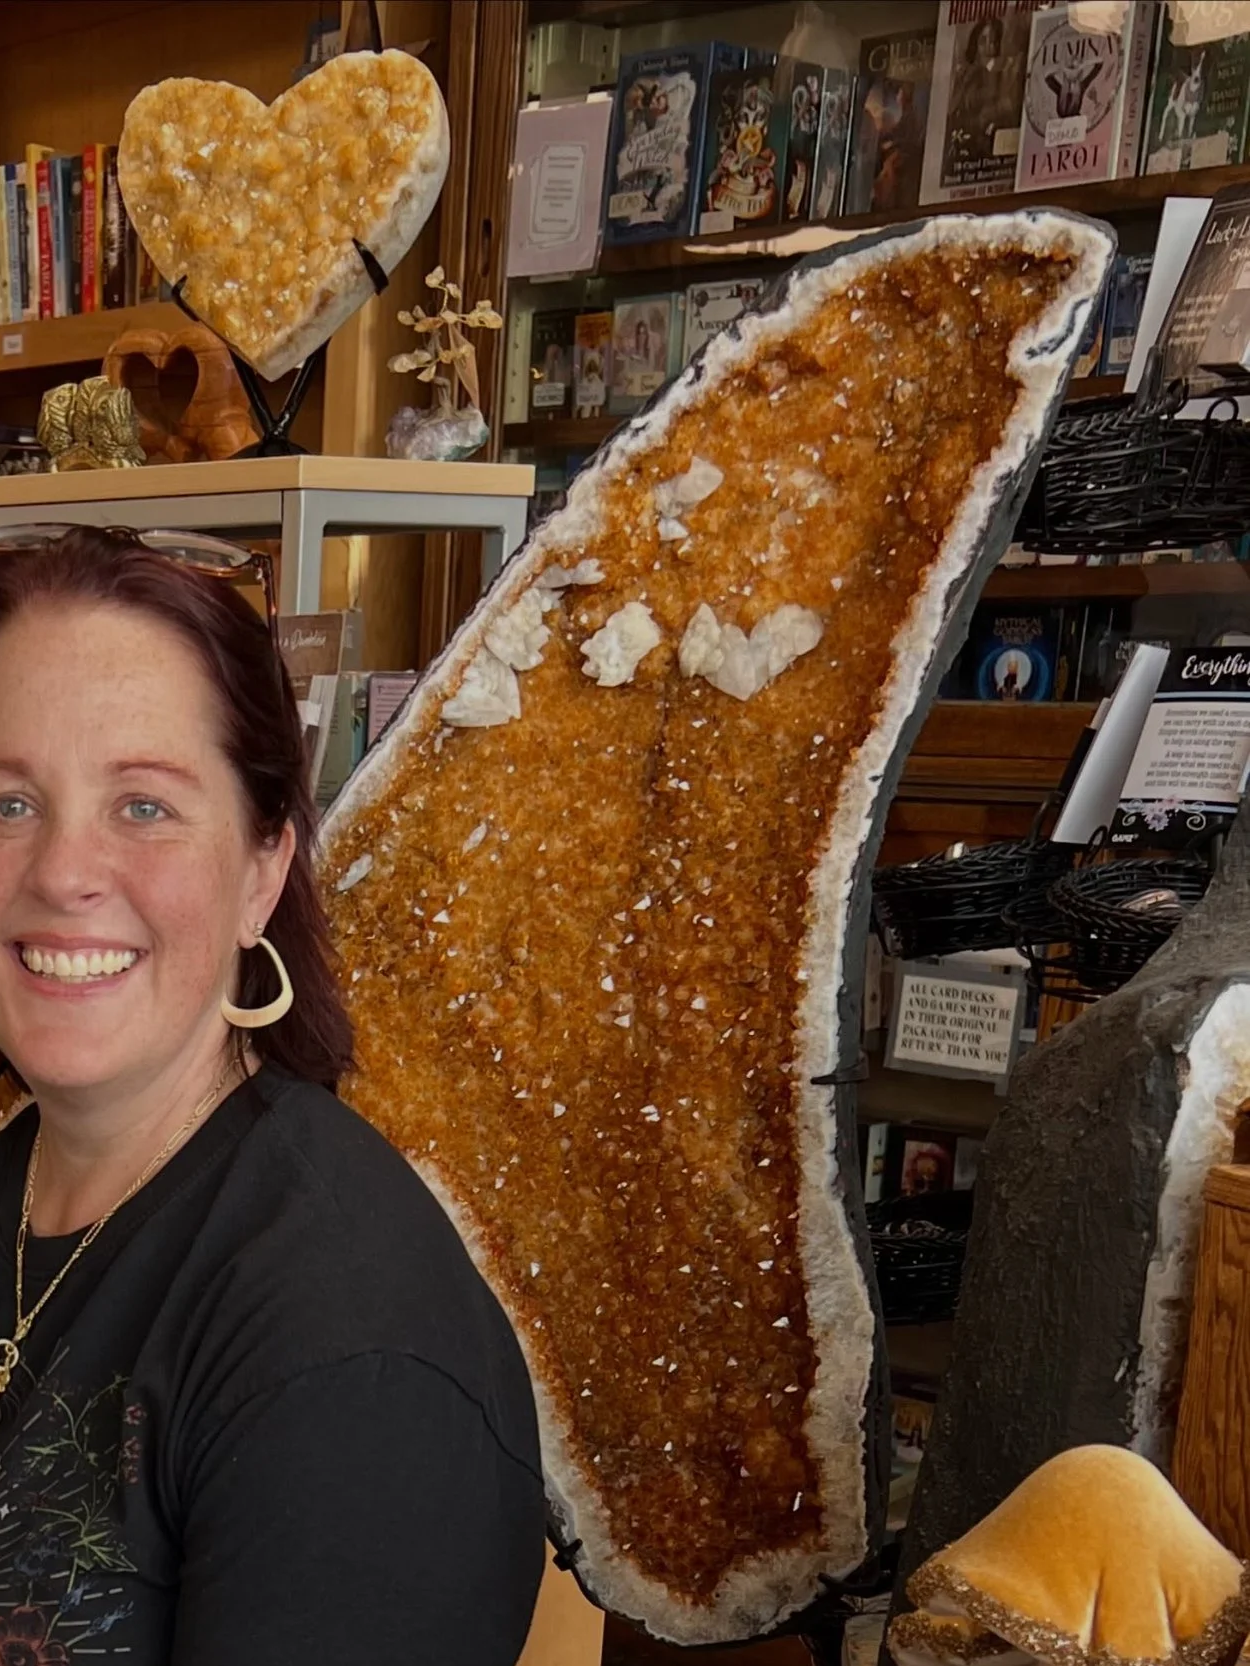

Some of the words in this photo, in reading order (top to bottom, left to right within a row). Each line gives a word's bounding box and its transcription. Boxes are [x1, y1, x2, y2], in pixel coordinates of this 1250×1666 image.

[1029, 145, 1100, 176] TAROT
[1182, 652, 1250, 686] Everythin
[910, 984, 927, 995] ALL
[930, 986, 959, 999] CARD
[960, 989, 995, 1003] DECKS
[908, 998, 928, 1009] AND
[929, 999, 967, 1013] GAMES
[969, 1004, 996, 1020] MUST
[998, 1008, 1011, 1021] BE
[905, 1010, 915, 1020] IN
[918, 1011, 948, 1026] THEIR
[949, 1016, 997, 1033] ORIGINAL
[902, 1023, 959, 1042] PACKAGING
[961, 1032, 982, 1045] FOR
[947, 1044, 981, 1060] THANK
